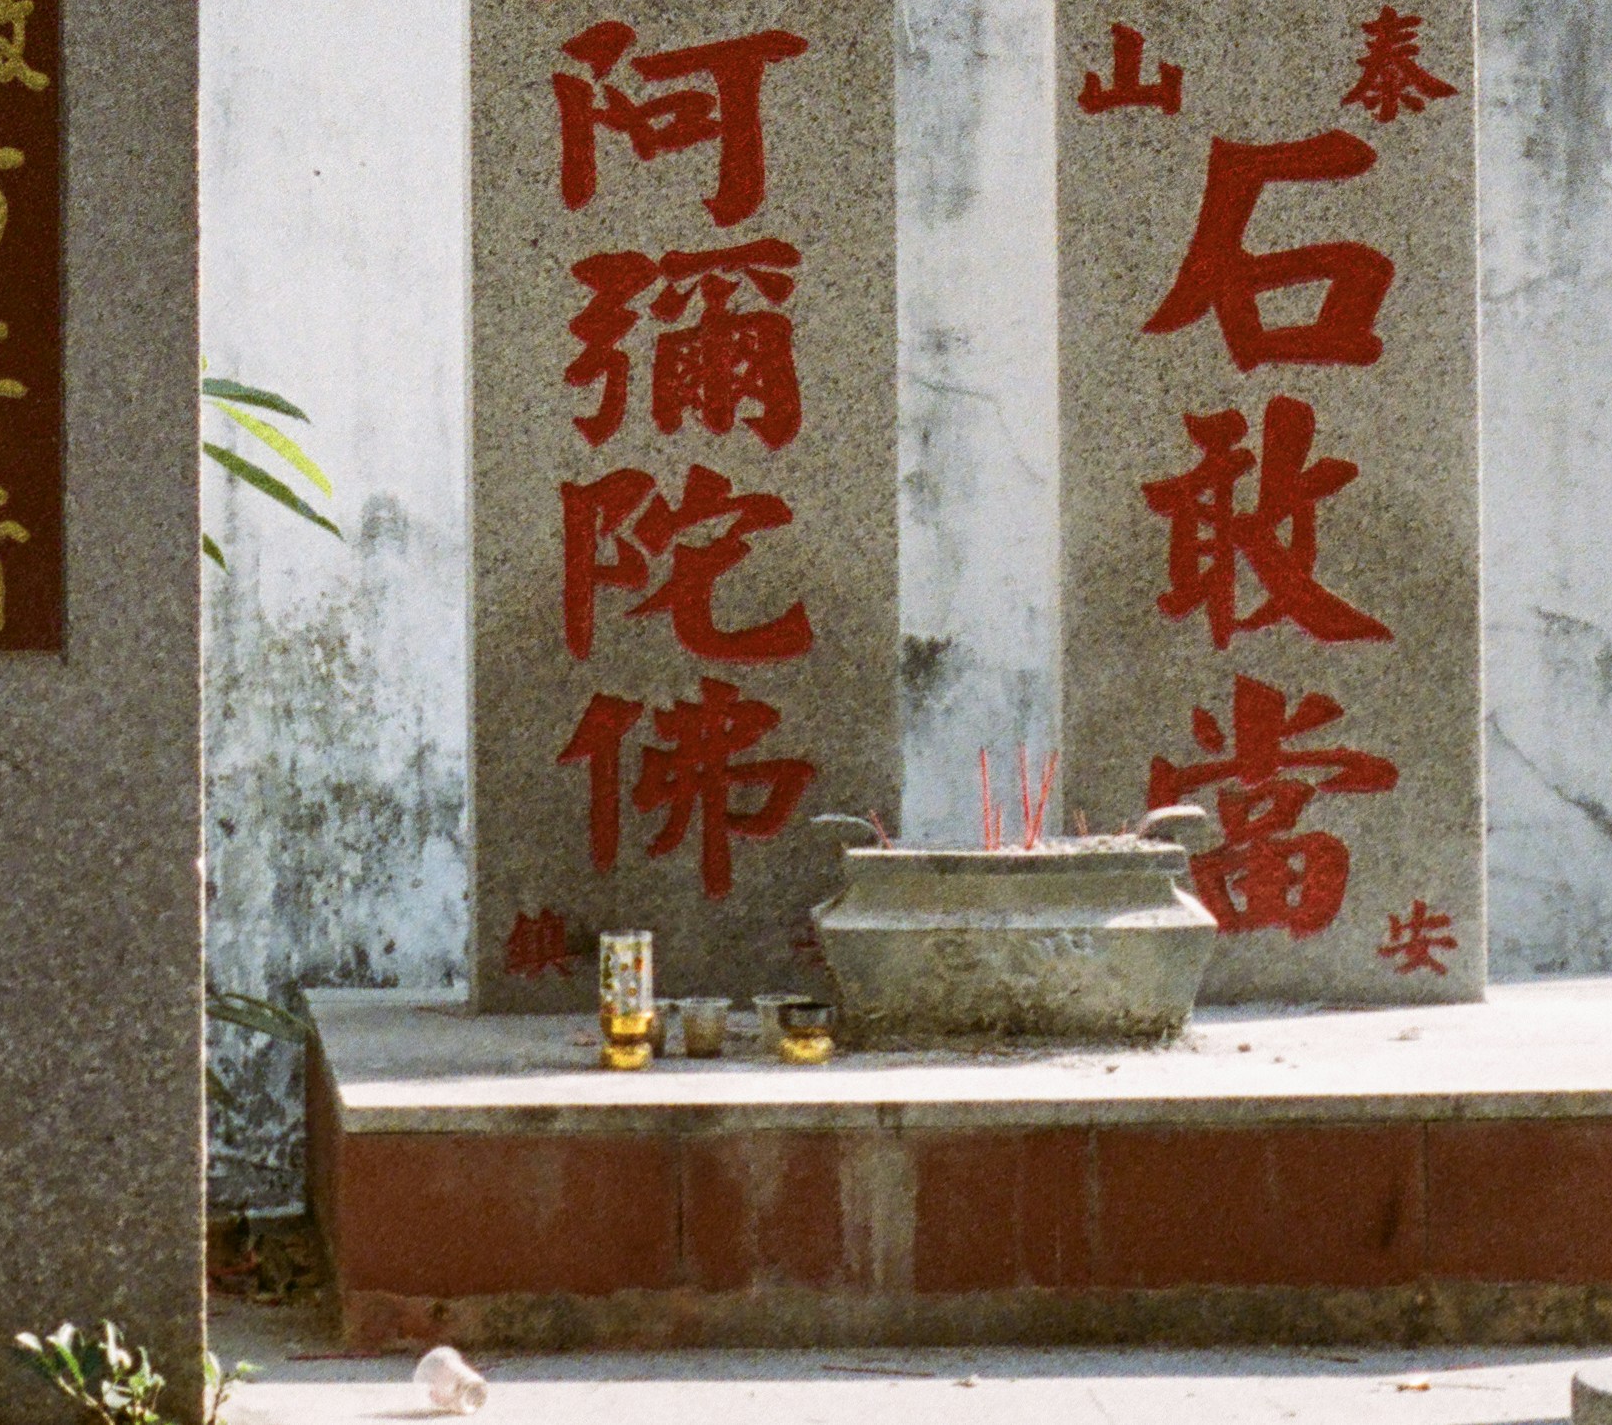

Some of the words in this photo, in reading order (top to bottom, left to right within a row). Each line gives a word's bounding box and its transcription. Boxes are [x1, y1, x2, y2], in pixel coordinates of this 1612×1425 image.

[1077, 22, 1185, 116] 山
[1339, 4, 1460, 123] 泰
[550, 19, 816, 901] 阿彌陀佛
[1139, 127, 1400, 941] 石敢當
[1377, 898, 1459, 977] 安
